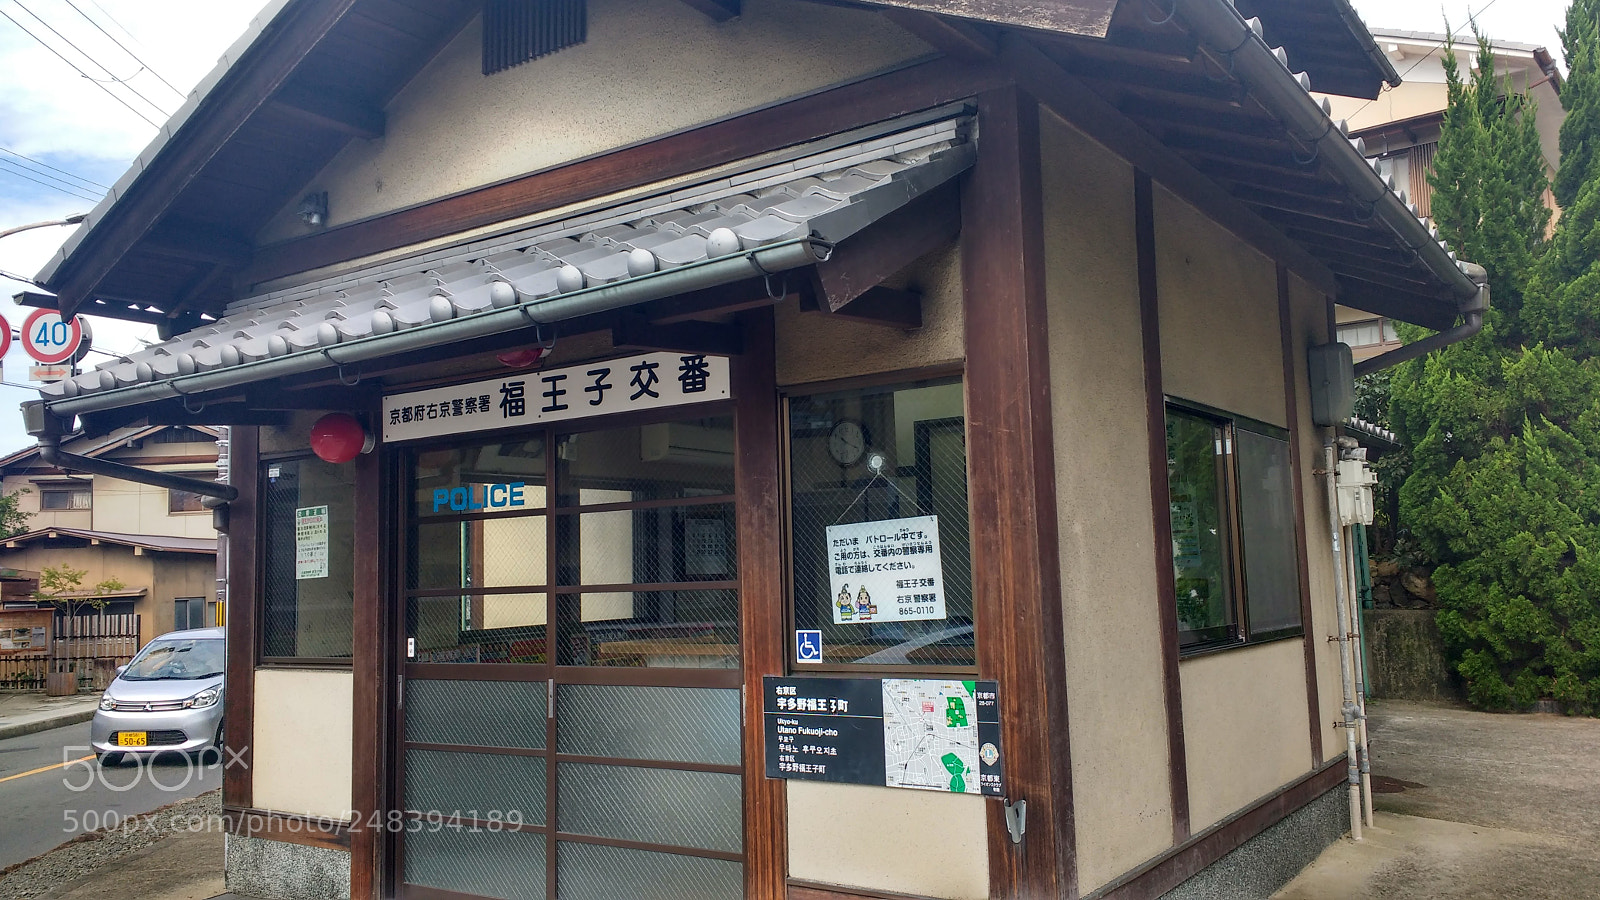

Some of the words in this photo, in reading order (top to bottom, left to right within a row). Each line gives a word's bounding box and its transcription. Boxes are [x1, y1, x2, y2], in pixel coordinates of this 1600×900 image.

[35, 321, 68, 347] 40
[389, 394, 491, 426] 京都府右京警察署
[499, 354, 711, 419] 福王子交番
[433, 481, 525, 513] POLICE
[832, 537, 859, 548] ただいま
[898, 606, 935, 616] 865-0110
[775, 685, 797, 696] 右京区
[776, 697, 849, 713] 宇多野福王子町
[777, 718, 799, 726] Ukyo-ku
[777, 725, 797, 735] Utano
[798, 726, 839, 738] Fukuoji-cho
